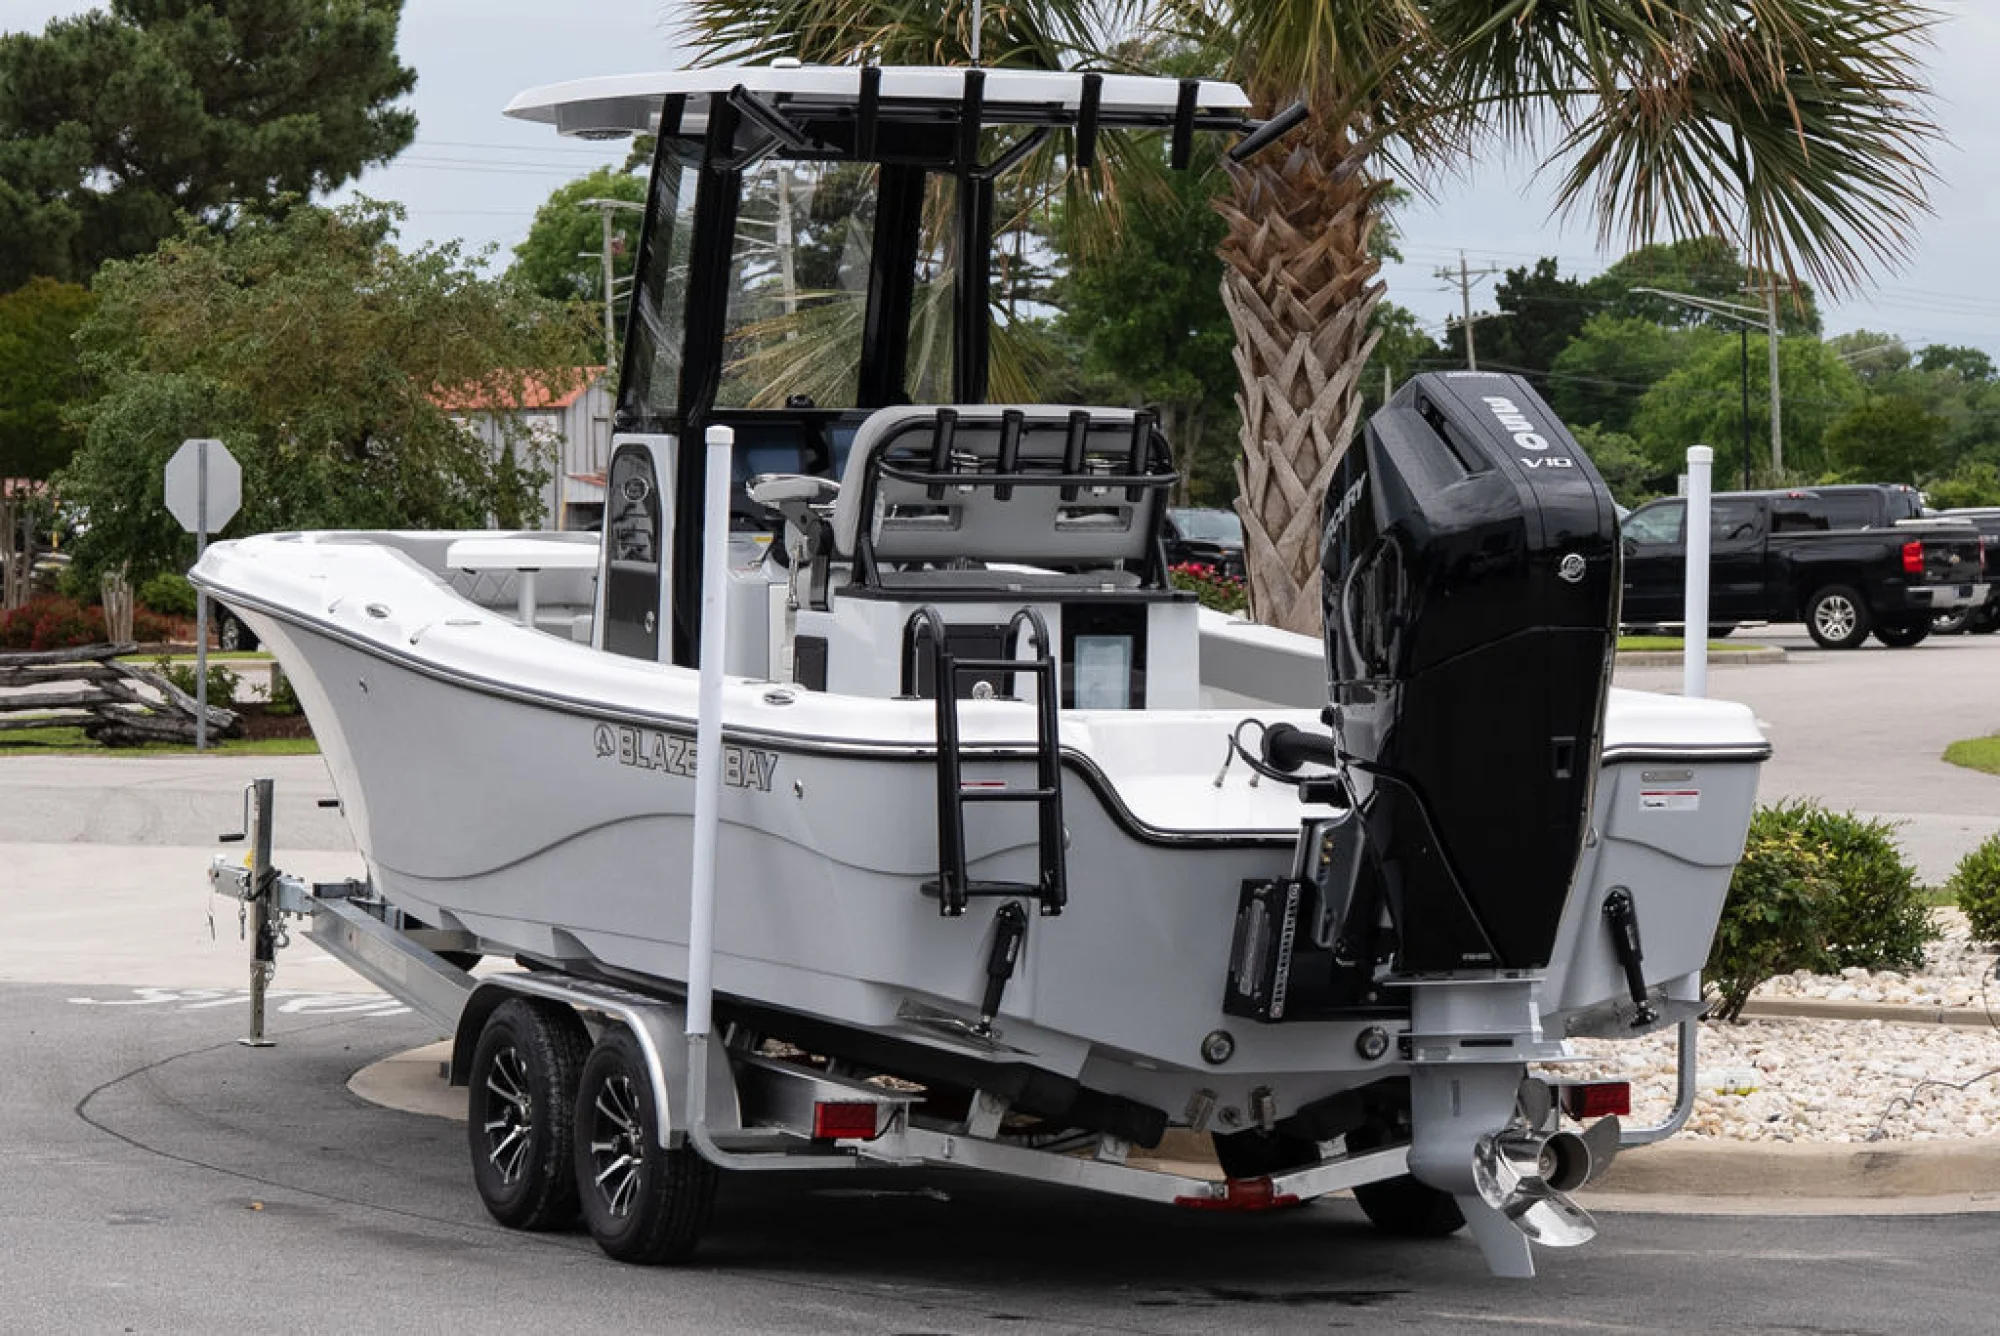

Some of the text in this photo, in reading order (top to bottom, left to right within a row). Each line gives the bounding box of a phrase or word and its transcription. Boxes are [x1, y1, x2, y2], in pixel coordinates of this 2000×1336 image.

[1520, 457, 1573, 468] V10
[619, 727, 779, 792] BLAZE BAY
